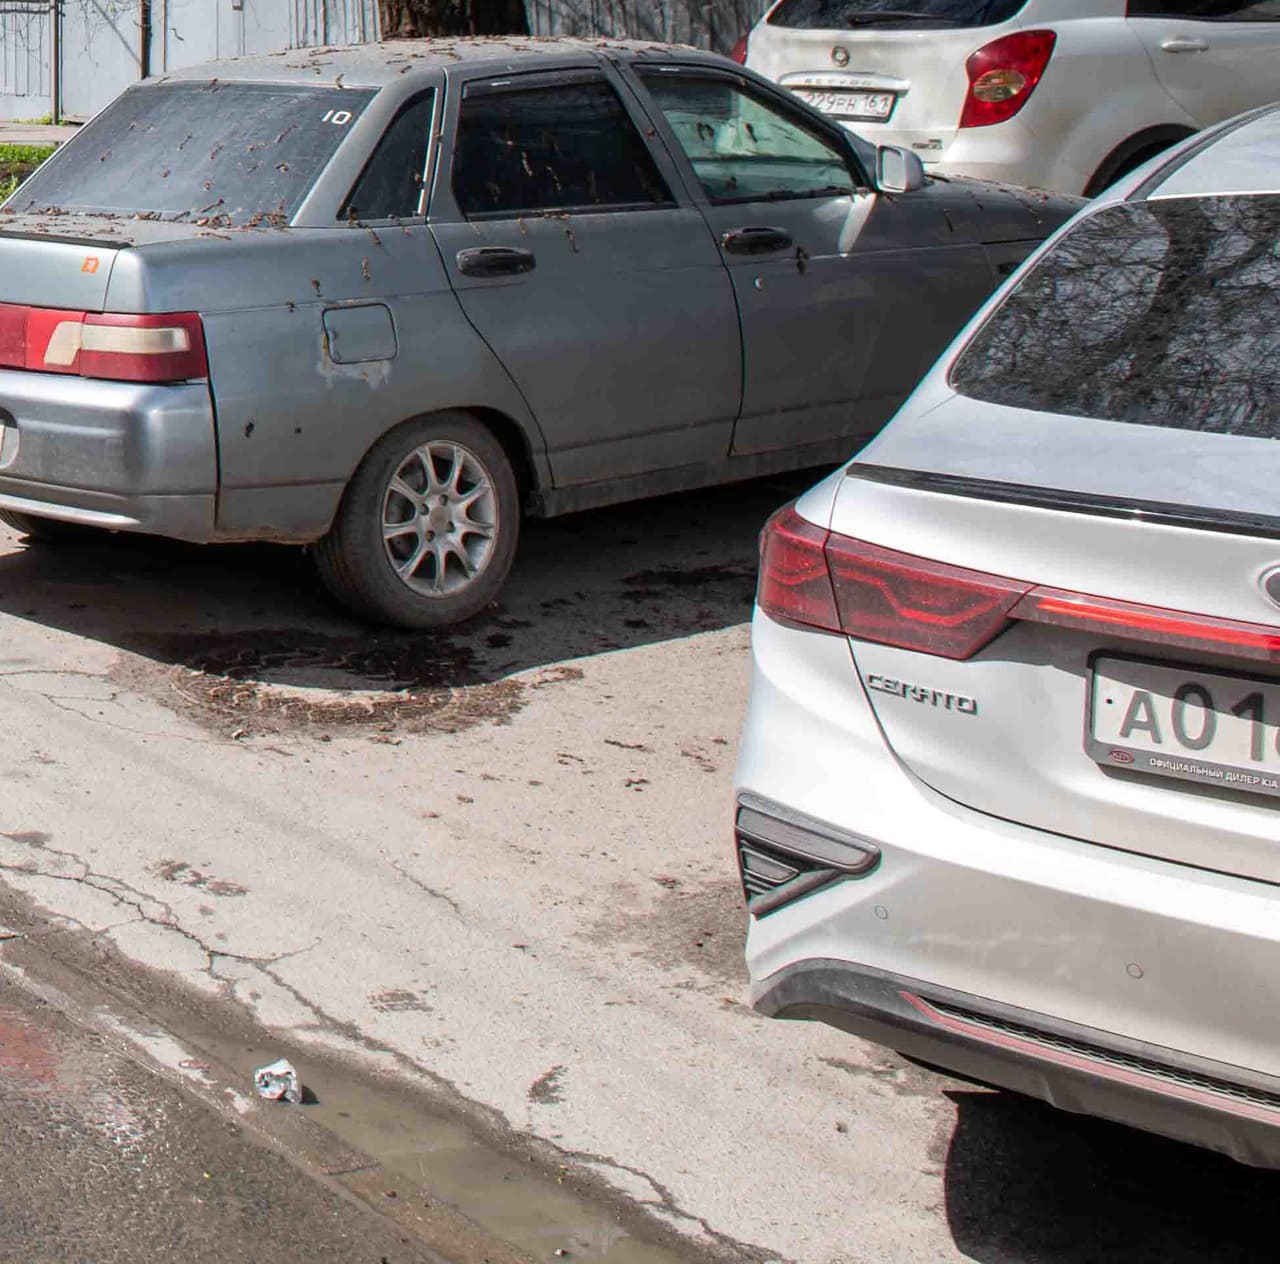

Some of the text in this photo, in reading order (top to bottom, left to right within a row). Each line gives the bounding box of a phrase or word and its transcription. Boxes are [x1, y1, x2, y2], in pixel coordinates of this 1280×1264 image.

[866, 673, 979, 716] CERATO
[1119, 681, 1280, 762] А01
[1149, 757, 1224, 779] ОФИЦИАЛЬНЫЙ
[1225, 771, 1261, 786] ДИЛЕР
